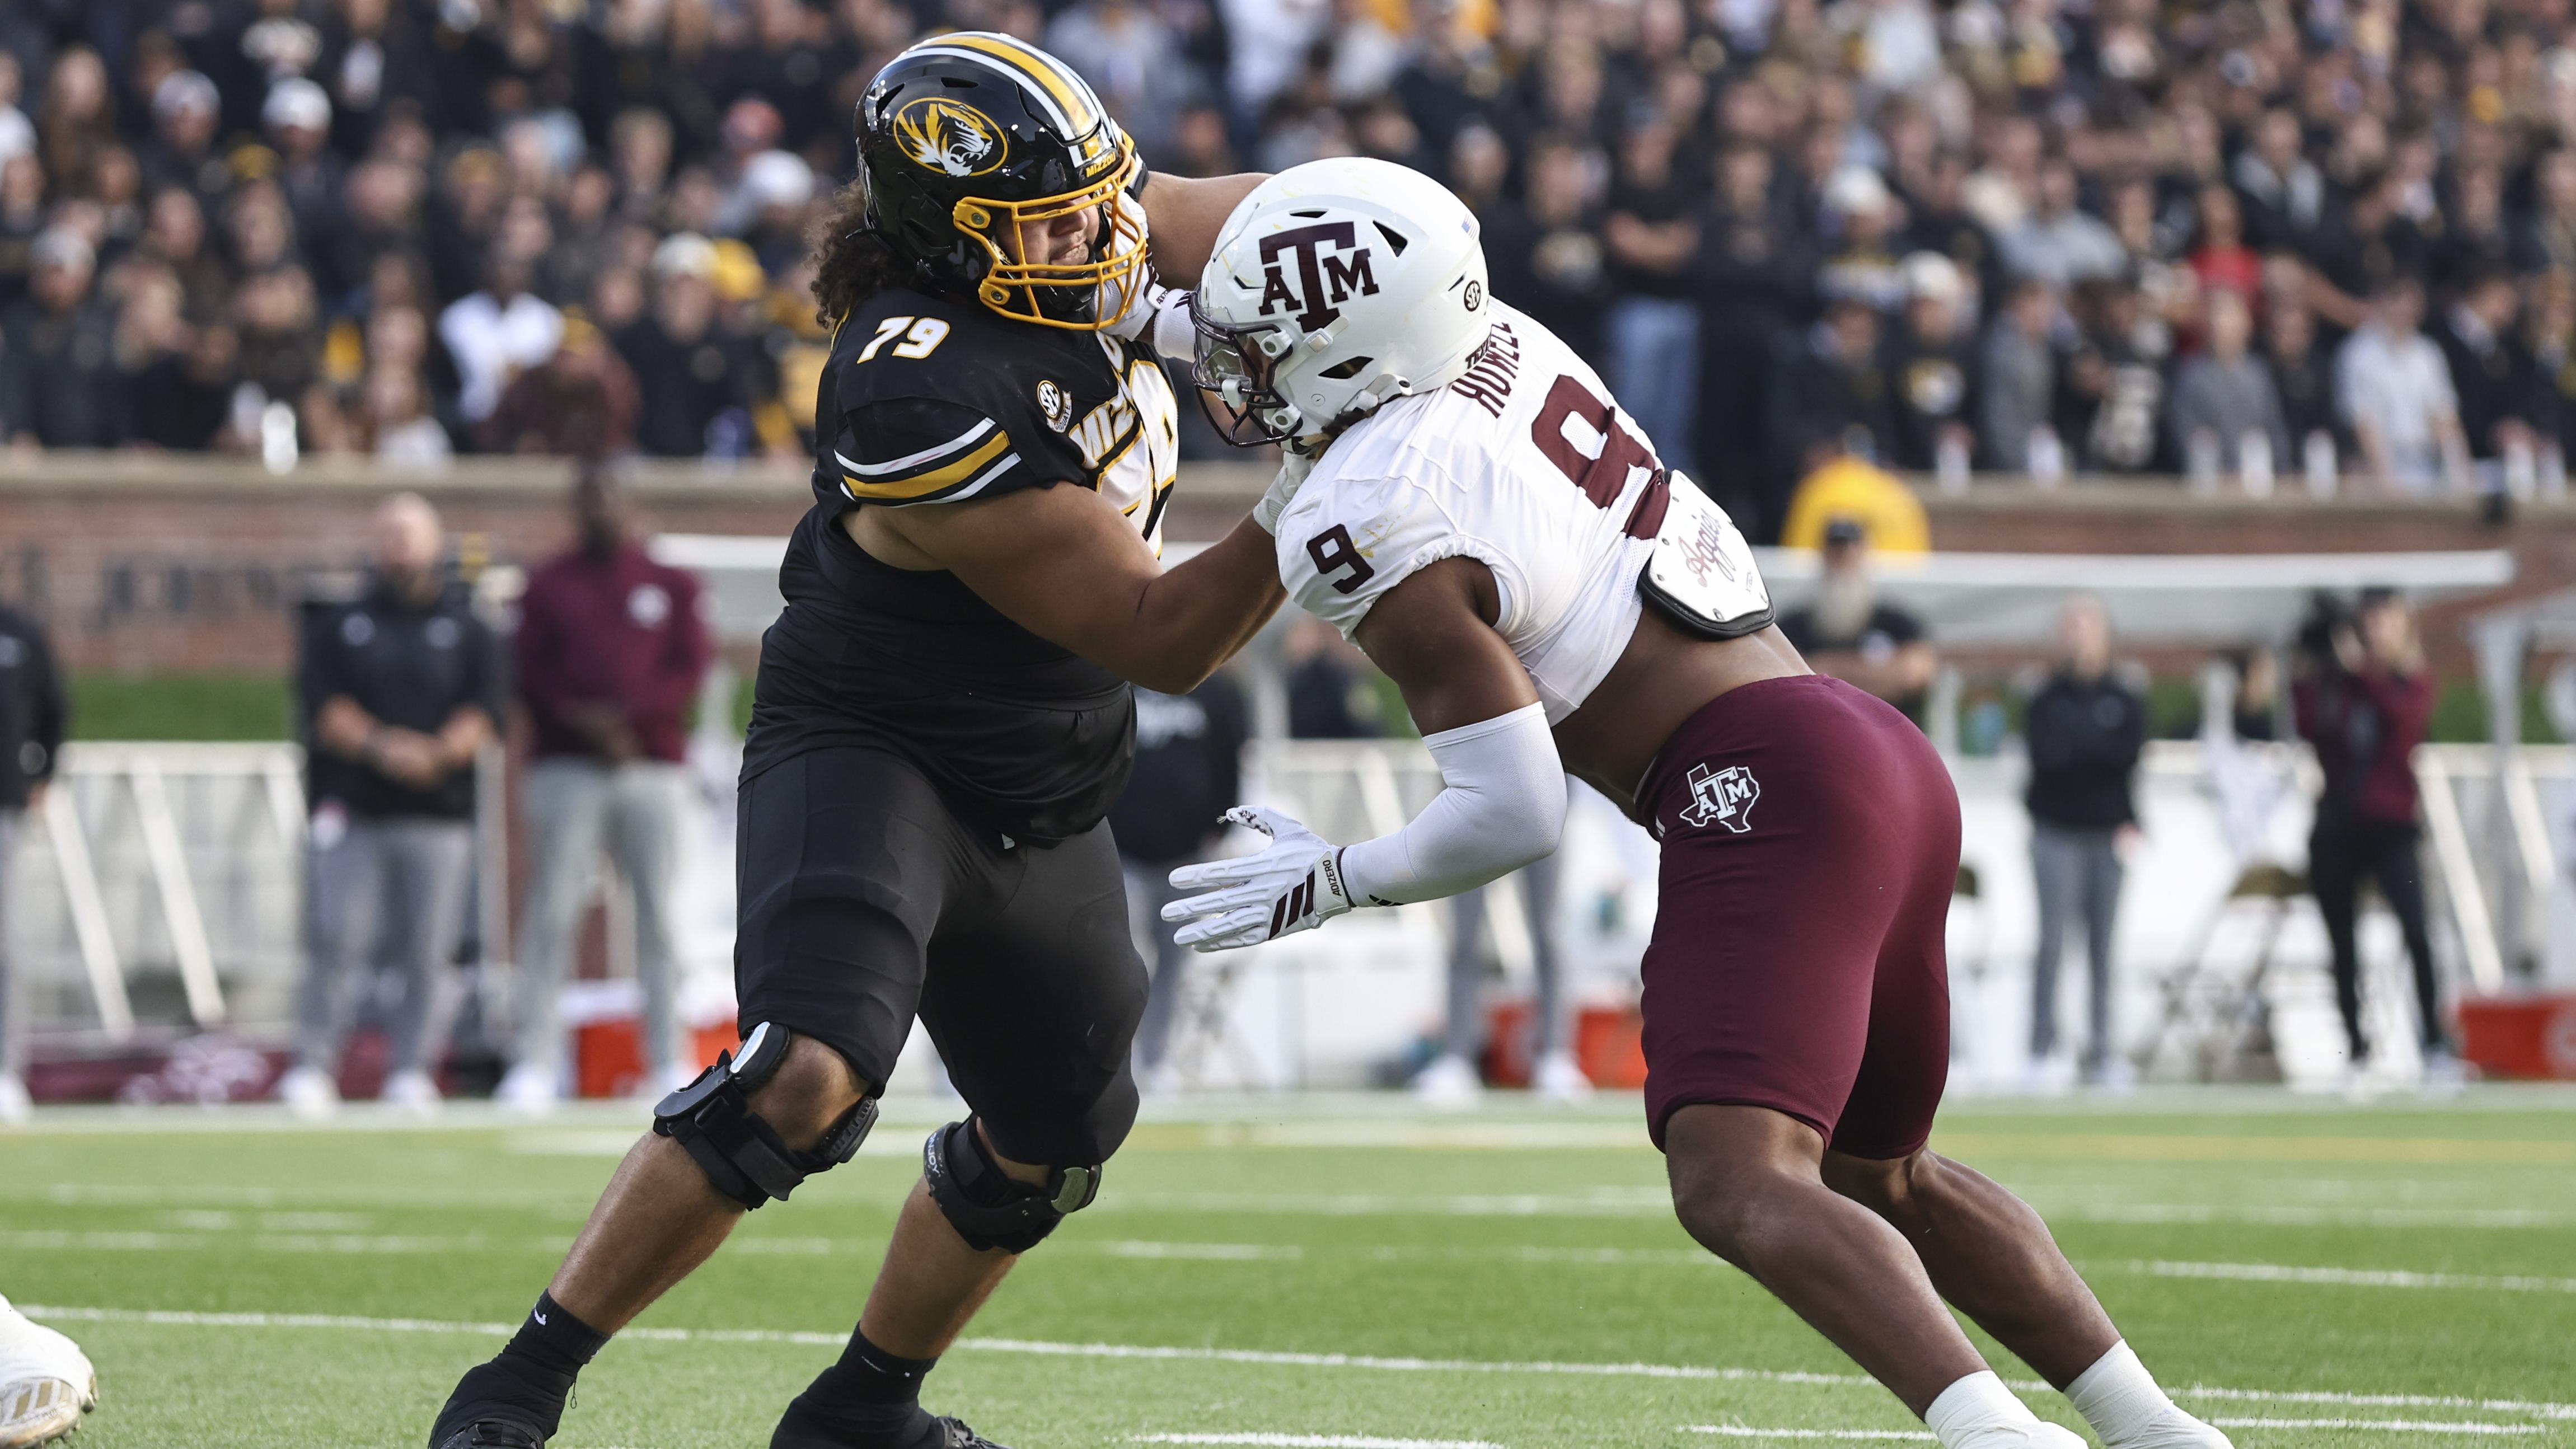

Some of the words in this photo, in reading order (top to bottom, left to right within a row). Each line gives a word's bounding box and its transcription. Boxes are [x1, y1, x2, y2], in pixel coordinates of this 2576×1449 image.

[1086, 152, 1116, 177] MIZZOU
[1465, 282, 1481, 308] SEC
[857, 316, 950, 363] 79
[1039, 383, 1060, 416] SEC
[1531, 374, 1670, 540] 9
[1306, 524, 1375, 594] 9
[1678, 508, 1736, 588] Aggies
[1323, 860, 1342, 897] ADIZERO
[928, 1132, 940, 1174] NJOY
